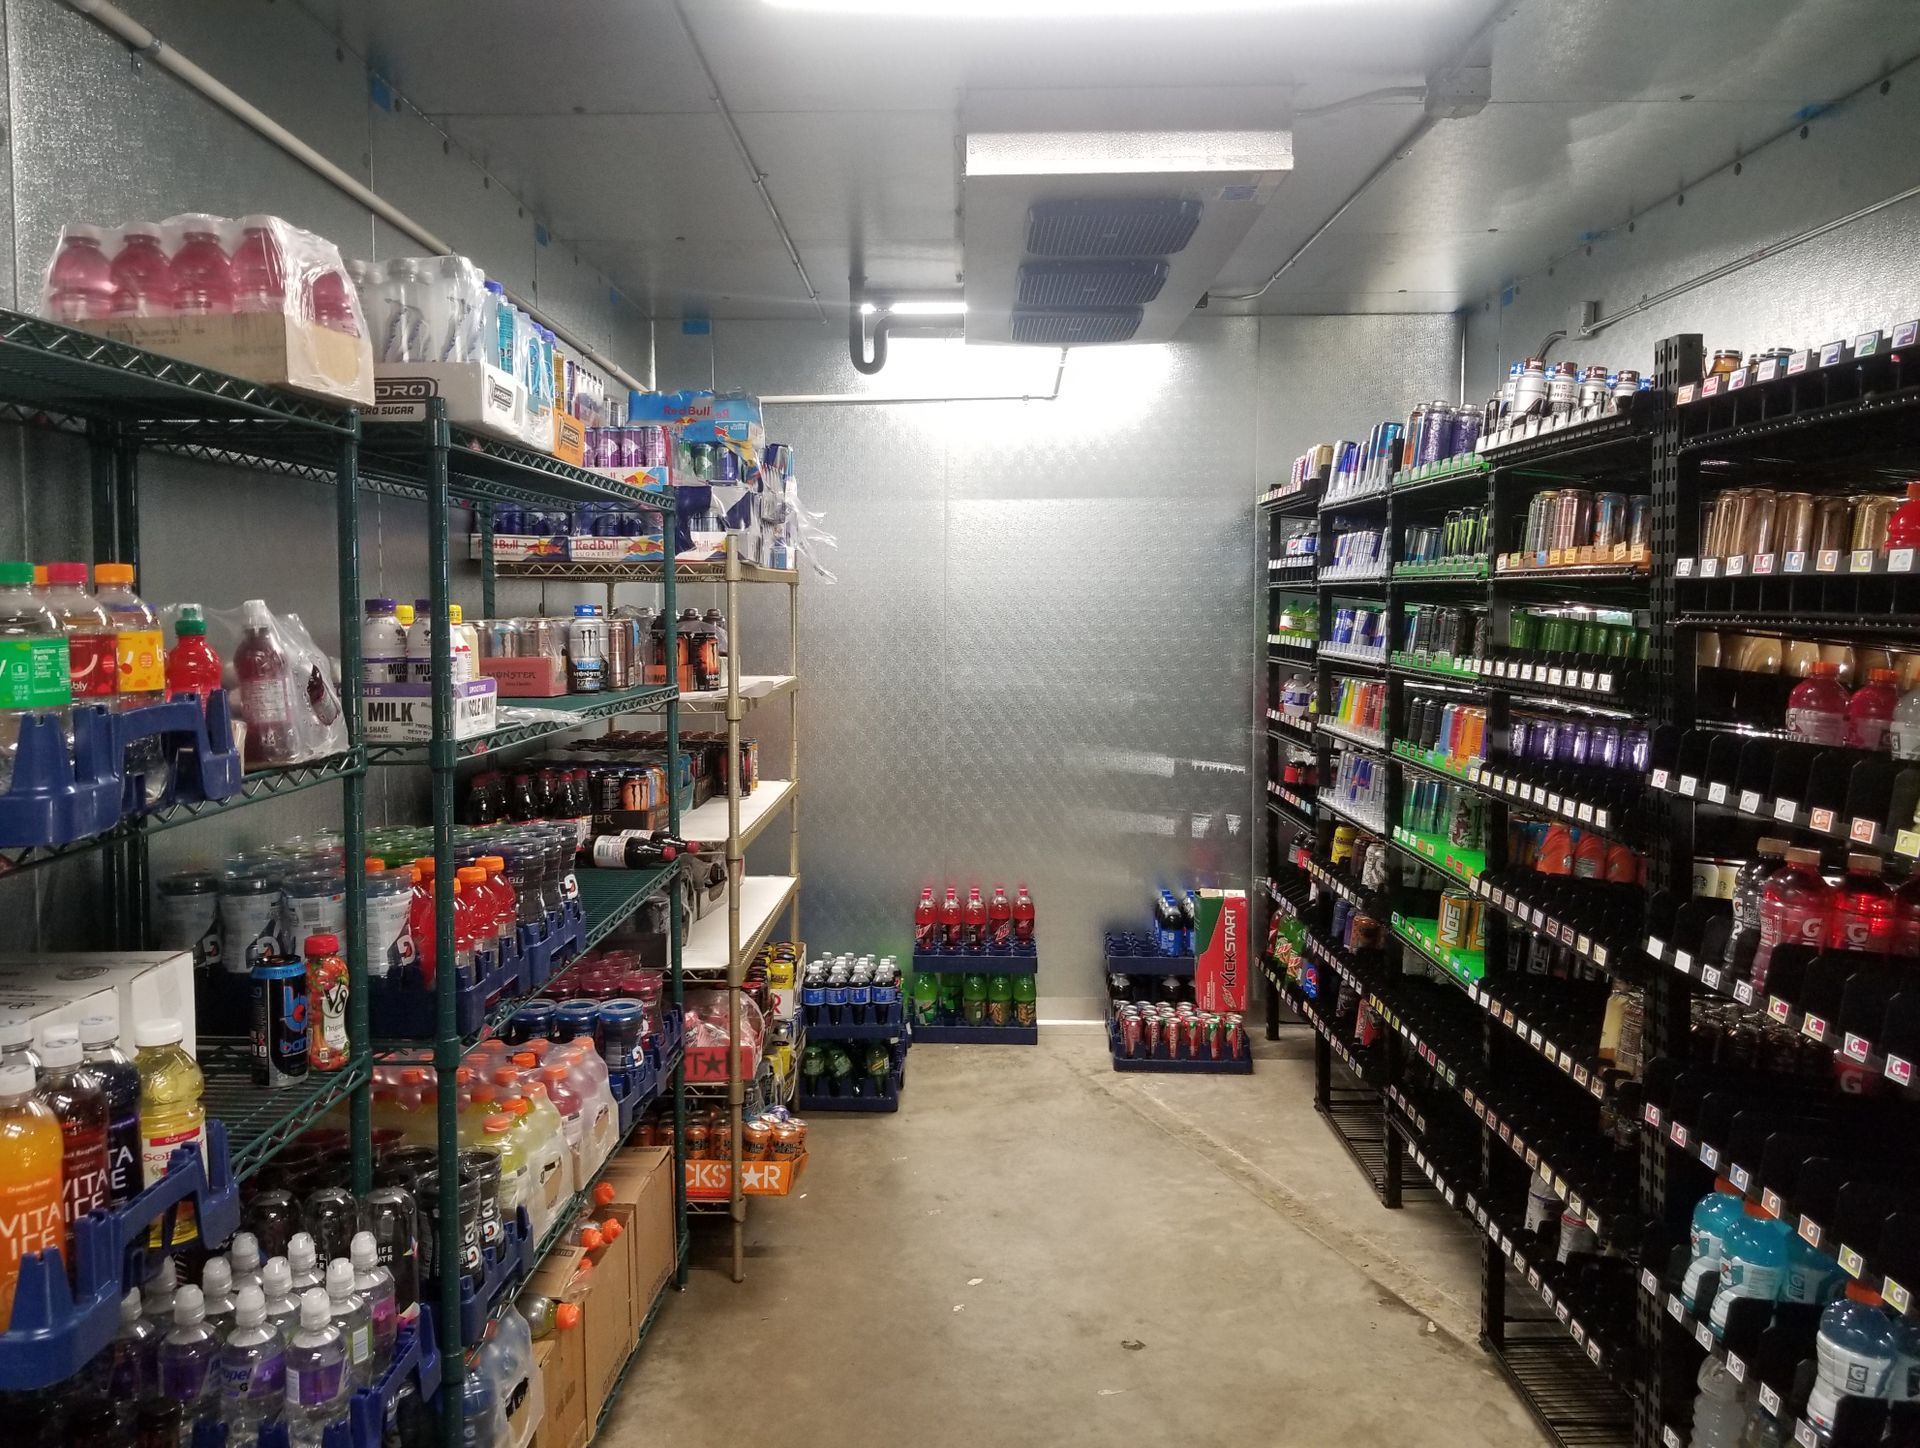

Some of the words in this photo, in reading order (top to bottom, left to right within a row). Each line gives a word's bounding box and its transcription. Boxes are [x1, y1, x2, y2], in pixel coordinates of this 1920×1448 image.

[381, 406, 414, 415] SUGAR
[663, 405, 686, 416] Red
[688, 406, 711, 416] Bull
[575, 540, 597, 551] Red
[599, 541, 620, 551] Bull
[1732, 558, 1739, 569] G
[1761, 556, 1769, 568] G
[1791, 554, 1799, 566] G
[1824, 552, 1833, 565] G
[1859, 553, 1868, 566] G
[1706, 561, 1713, 572] G
[367, 702, 414, 722] MILK
[369, 726, 389, 734] SHAKE
[1813, 809, 1822, 823] G
[1853, 821, 1863, 835] G
[1733, 897, 1743, 917] G
[1441, 900, 1462, 945] NOS
[1802, 917, 1823, 938] G
[1731, 920, 1743, 940] 2
[1847, 922, 1870, 943] G
[1220, 906, 1236, 988] KICKSTART
[1738, 985, 1750, 997] G2
[323, 983, 349, 1014] V8
[1772, 1002, 1781, 1013] G
[1808, 1018, 1817, 1031] G
[1850, 1038, 1860, 1051] G
[1891, 1061, 1901, 1075] G
[1840, 1070, 1865, 1094] G
[1650, 1108, 1657, 1120] G
[1676, 1127, 1684, 1140] G
[1706, 1148, 1714, 1161] G
[1736, 1170, 1744, 1182] G
[1769, 1196, 1777, 1209] G
[0, 1201, 62, 1238] VITA
[1806, 1223, 1816, 1237] G
[10, 1226, 57, 1261] ICE
[1847, 1252, 1858, 1268] G
[1647, 1275, 1654, 1286] G
[1892, 1286, 1904, 1303] G
[1673, 1303, 1680, 1313] G
[1701, 1330, 1709, 1342] G
[1733, 1361, 1741, 1372] G
[1766, 1393, 1775, 1405] G
[1802, 1428, 1812, 1442] G
